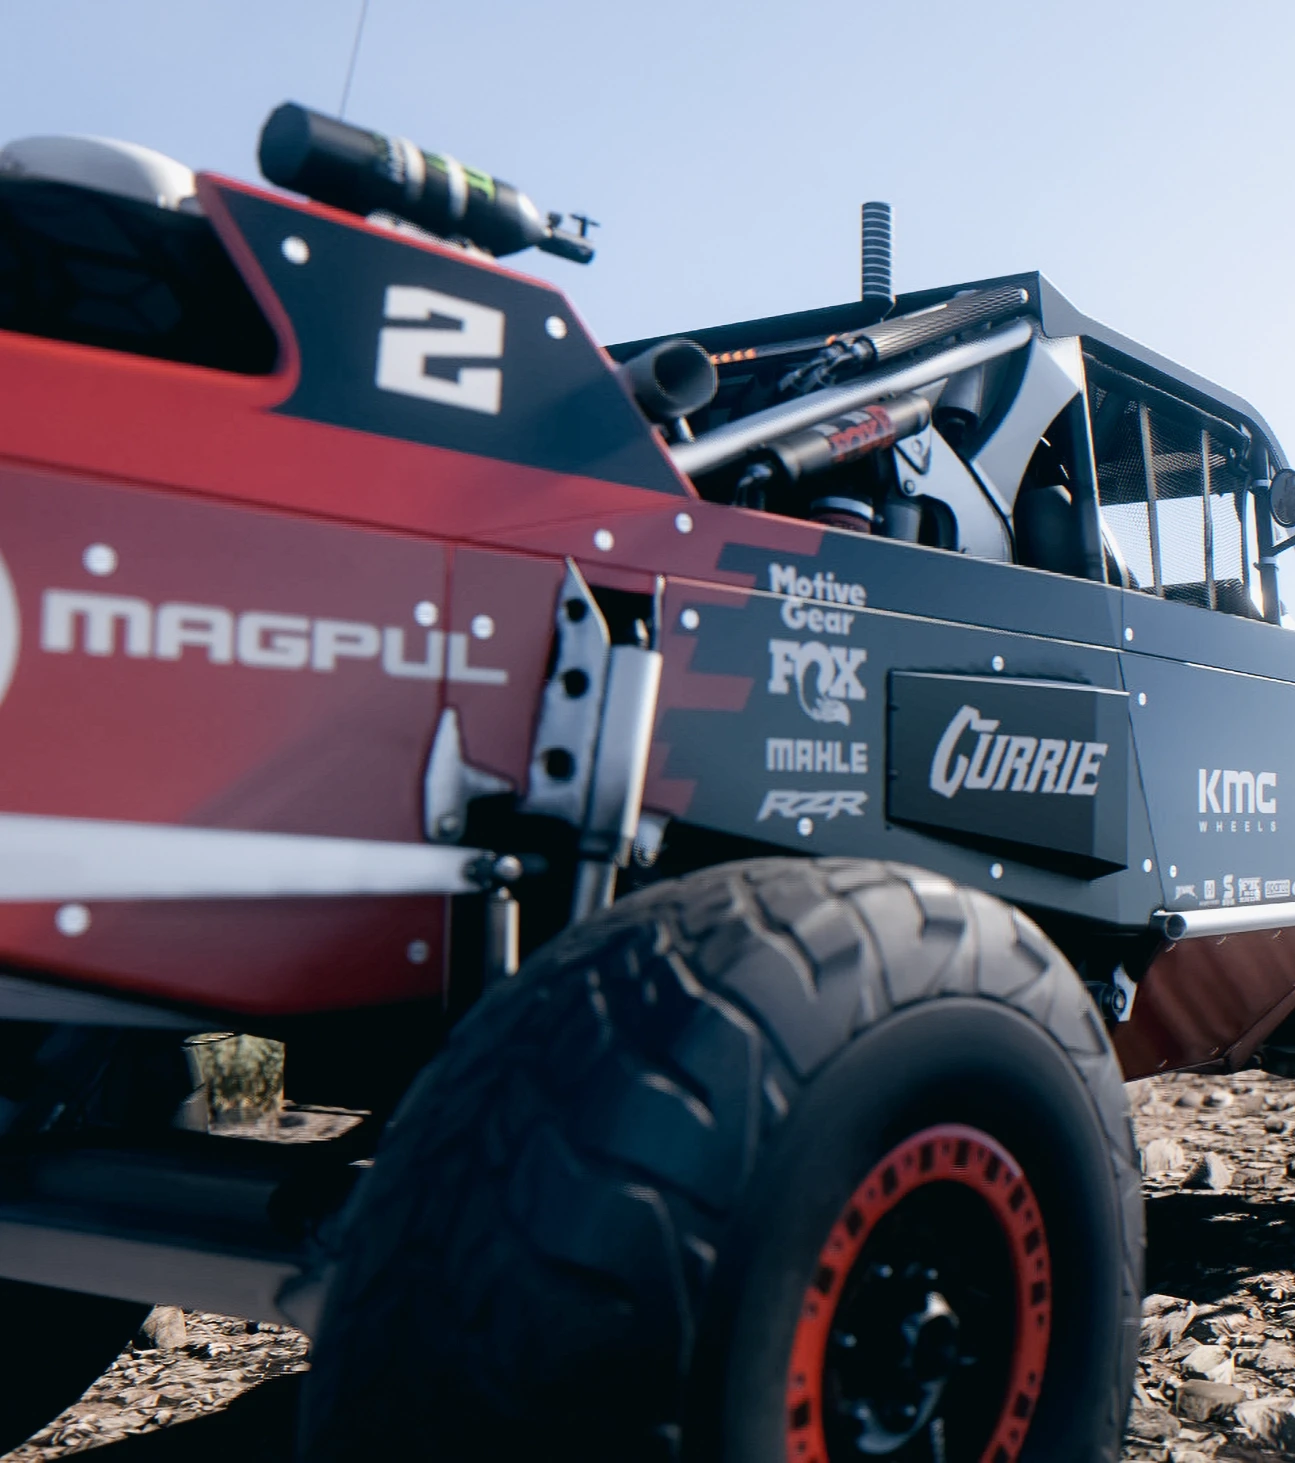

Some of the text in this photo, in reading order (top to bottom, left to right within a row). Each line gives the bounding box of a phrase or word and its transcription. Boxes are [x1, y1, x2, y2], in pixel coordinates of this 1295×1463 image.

[375, 284, 505, 415] 2
[769, 562, 867, 607] Motive
[40, 588, 508, 685] MAGPUL
[780, 600, 856, 635] Gear
[768, 638, 867, 726] FOX
[766, 738, 868, 774] MAHLE
[929, 704, 1108, 799] CURRIE
[757, 789, 868, 821] RZR
[1198, 768, 1277, 814] KMC
[1199, 820, 1277, 833] WHEELS
